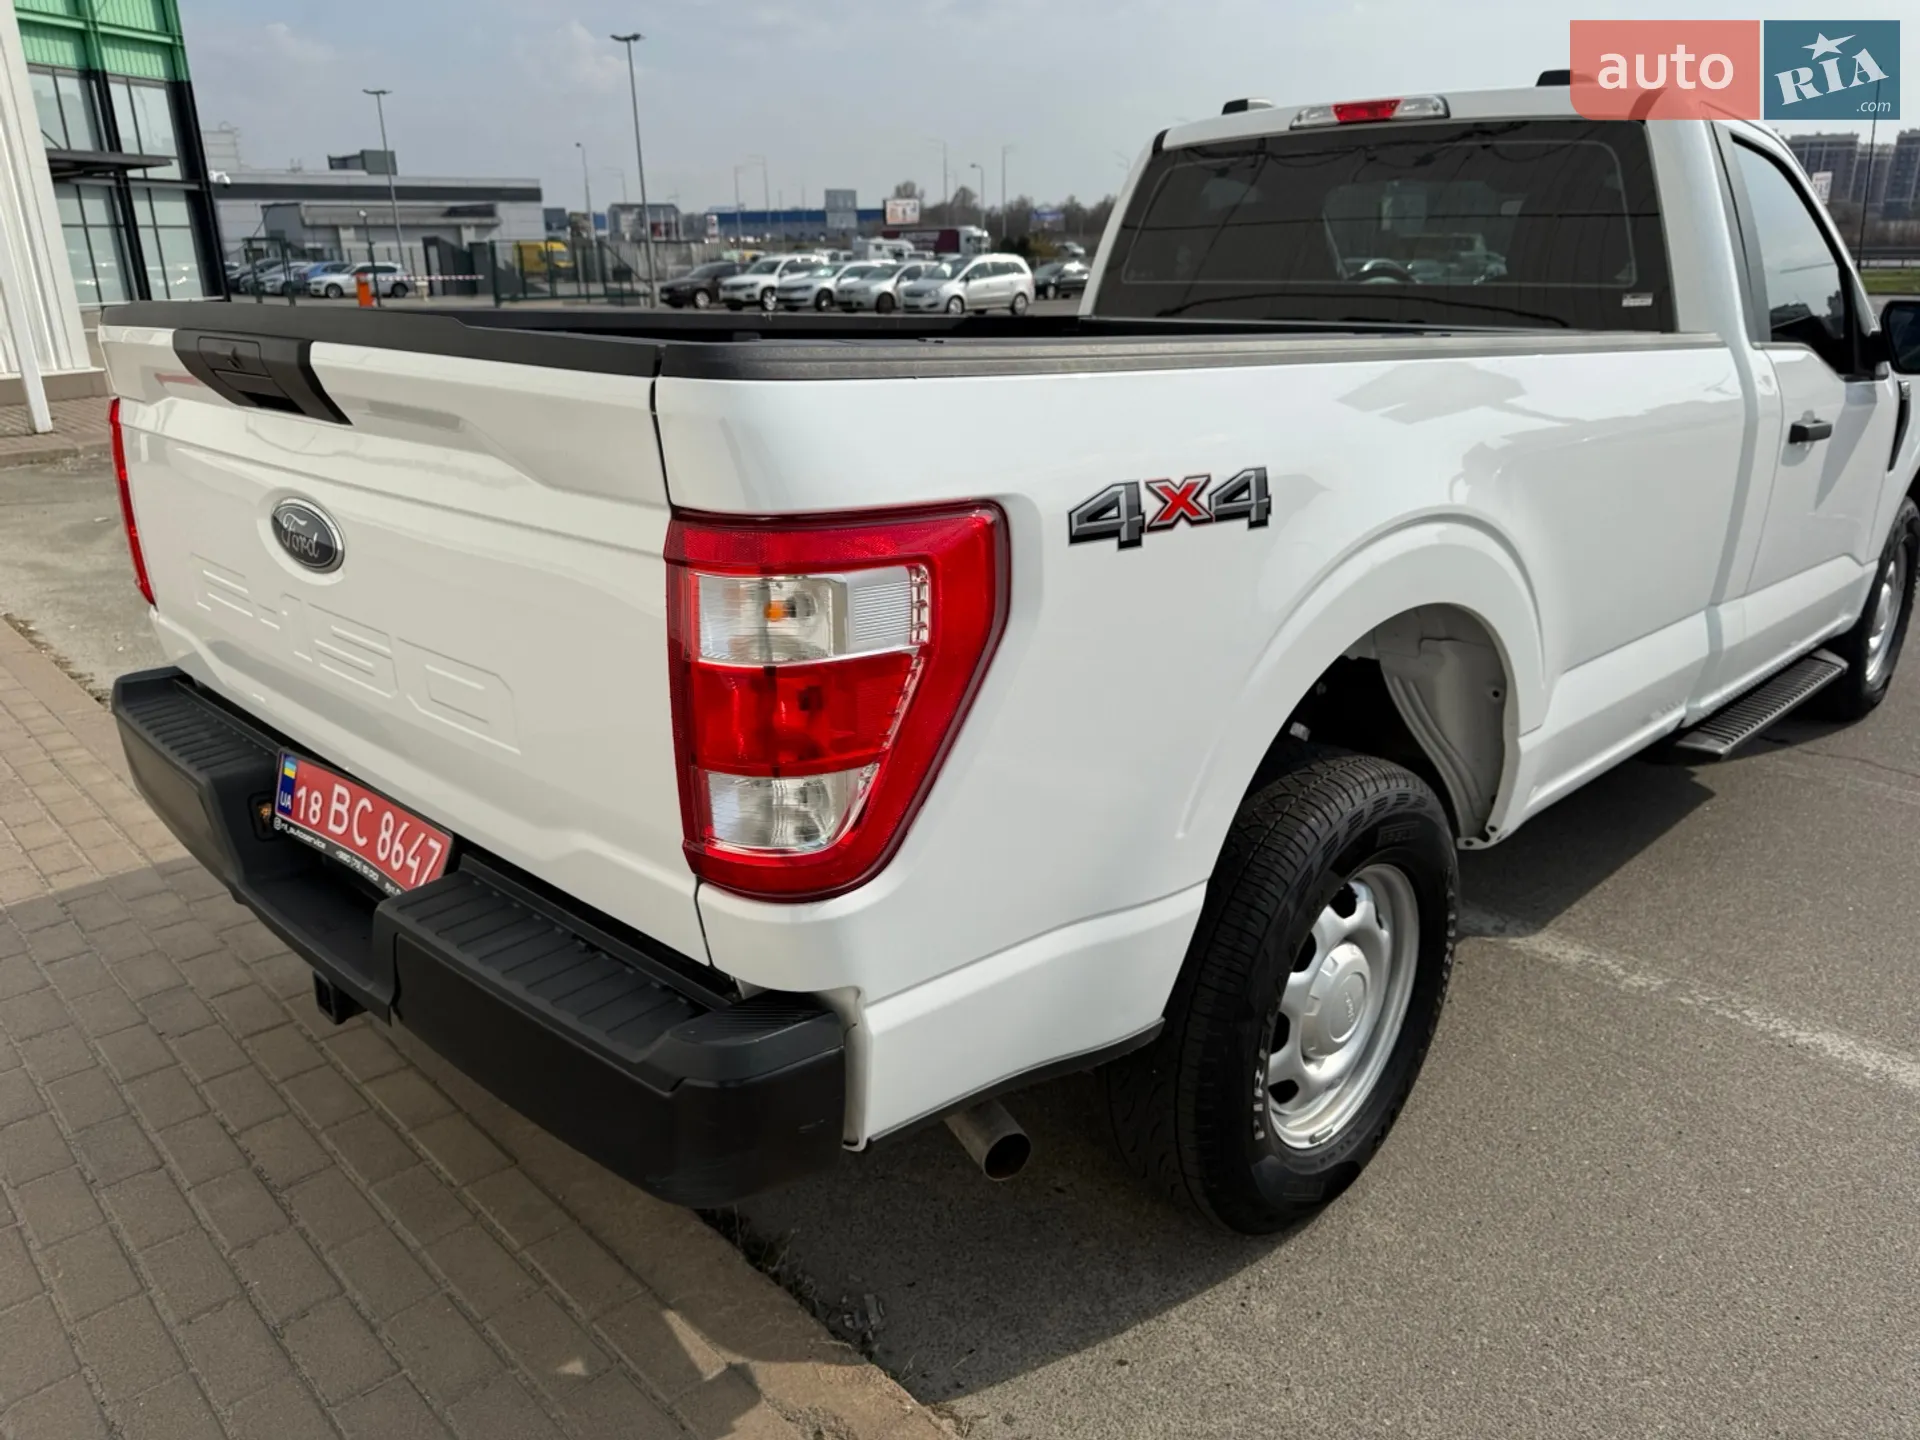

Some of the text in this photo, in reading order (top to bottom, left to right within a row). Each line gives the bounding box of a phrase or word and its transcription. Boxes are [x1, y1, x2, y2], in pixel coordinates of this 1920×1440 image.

[280, 511, 321, 560] Ford
[190, 552, 522, 756] F-150
[280, 791, 292, 809] UA
[296, 785, 323, 825] 18
[328, 783, 373, 847] BC
[376, 811, 443, 887] 8647
